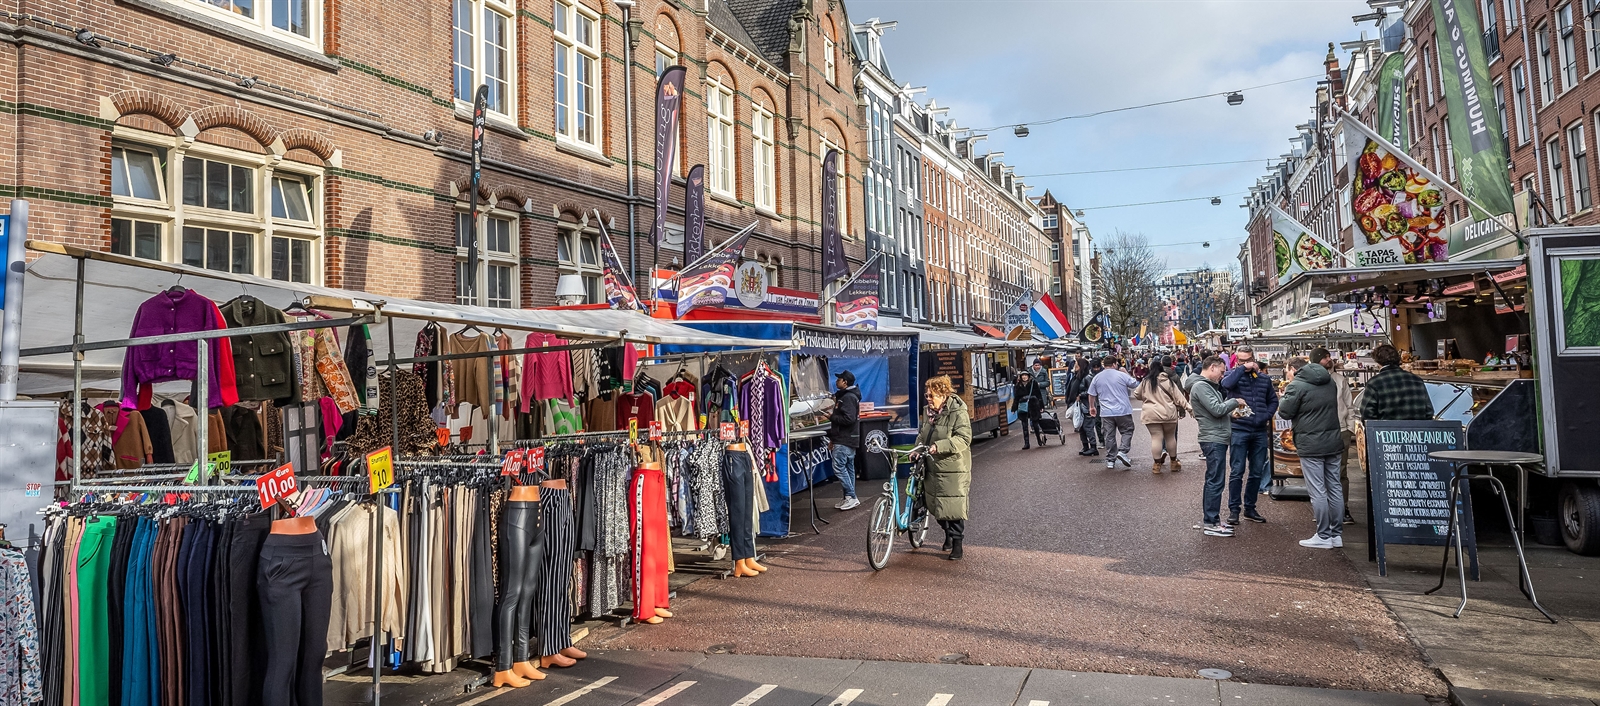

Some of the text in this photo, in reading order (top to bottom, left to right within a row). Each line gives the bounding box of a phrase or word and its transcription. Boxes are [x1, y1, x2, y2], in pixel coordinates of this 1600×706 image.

[1365, 249, 1395, 257] TAPAS
[1365, 256, 1398, 264] TRUCK
[800, 330, 839, 348] Frisdranken
[847, 334, 865, 354] Haring
[1376, 431, 1456, 444] MEDITERRANEAN BUNS
[1385, 462, 1405, 470] SWEET
[1386, 471, 1407, 479] HUMMUS
